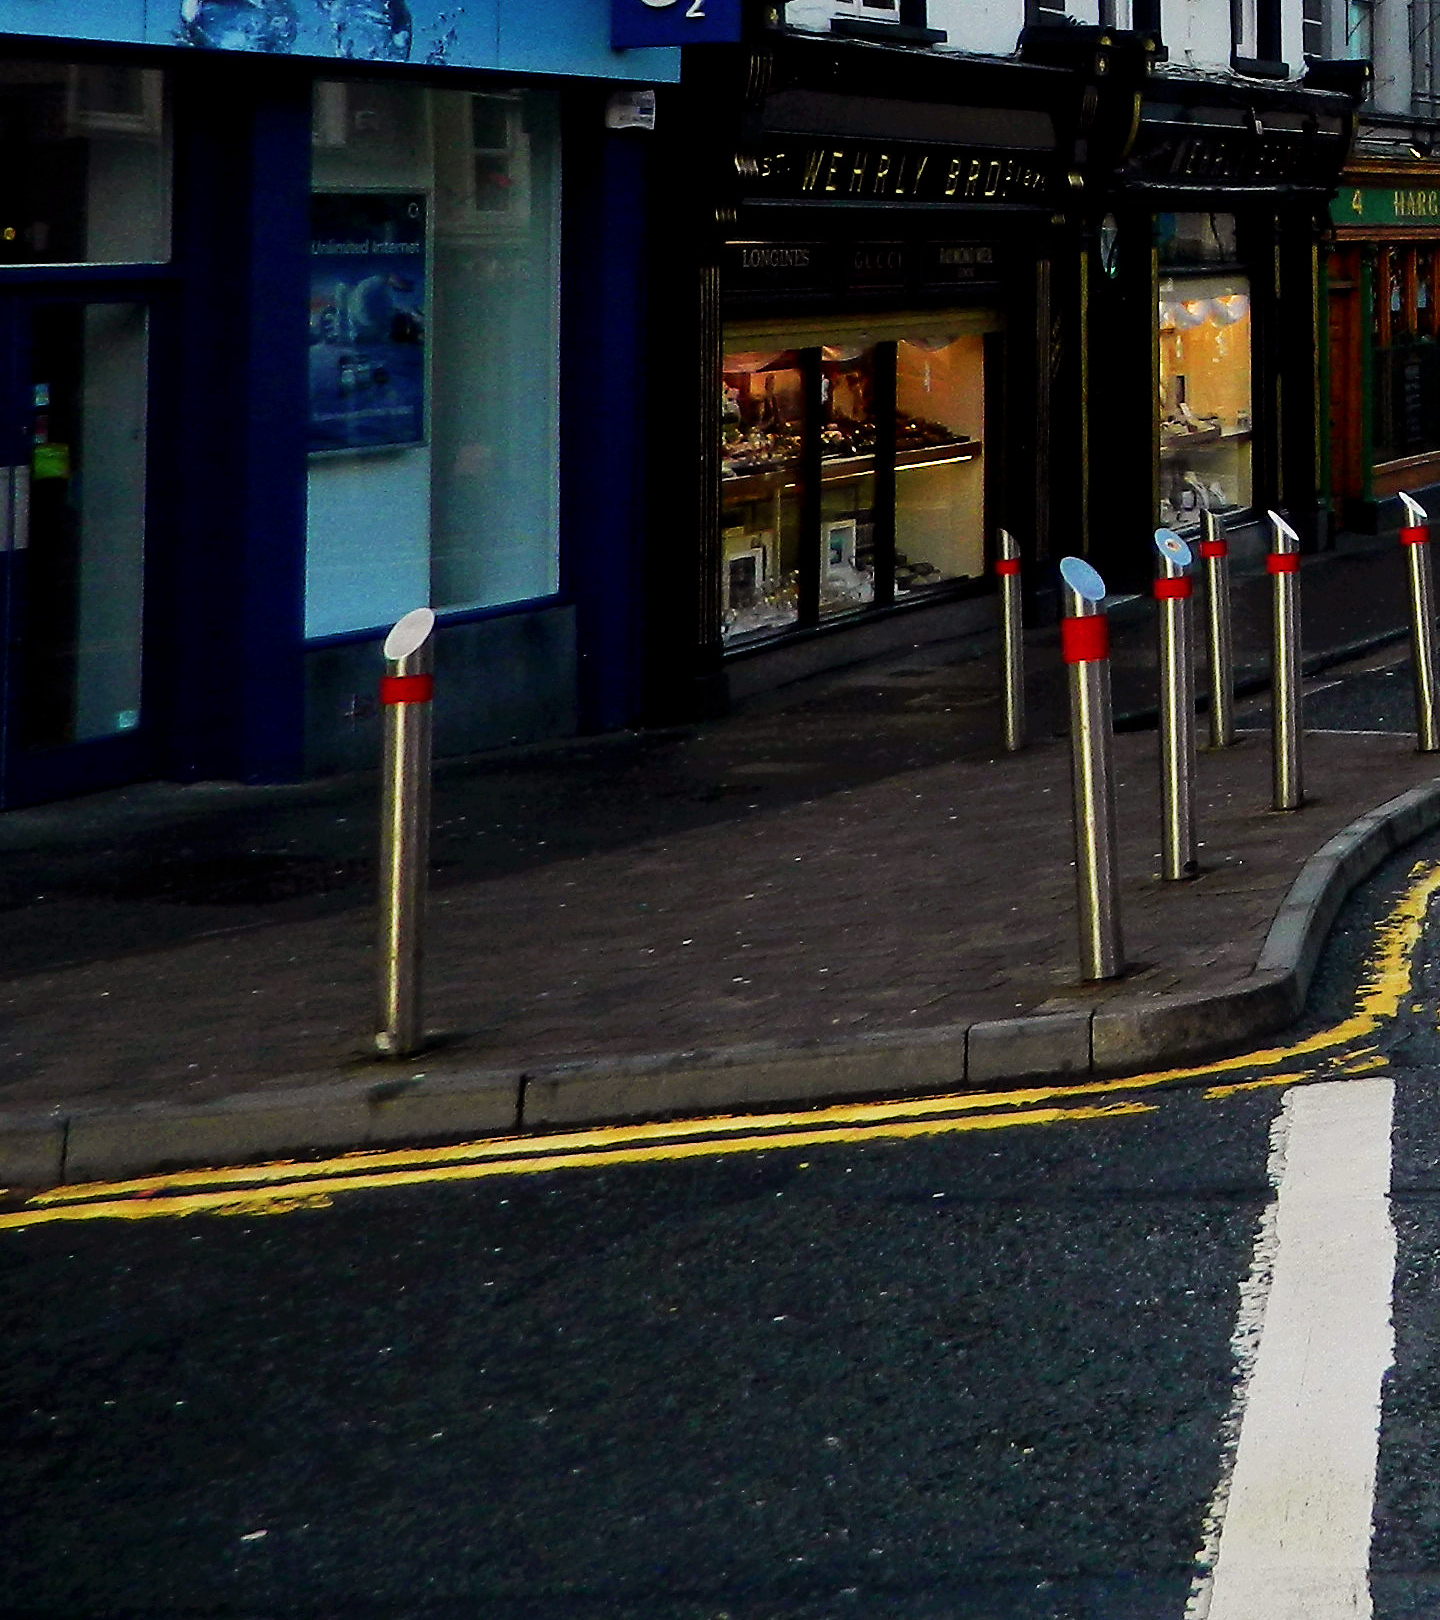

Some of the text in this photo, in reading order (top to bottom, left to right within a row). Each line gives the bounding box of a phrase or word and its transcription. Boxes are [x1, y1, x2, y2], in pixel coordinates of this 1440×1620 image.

[802, 149, 929, 196] WEHRLY
[1351, 189, 1363, 215] 4
[742, 248, 810, 268] LONGINES
